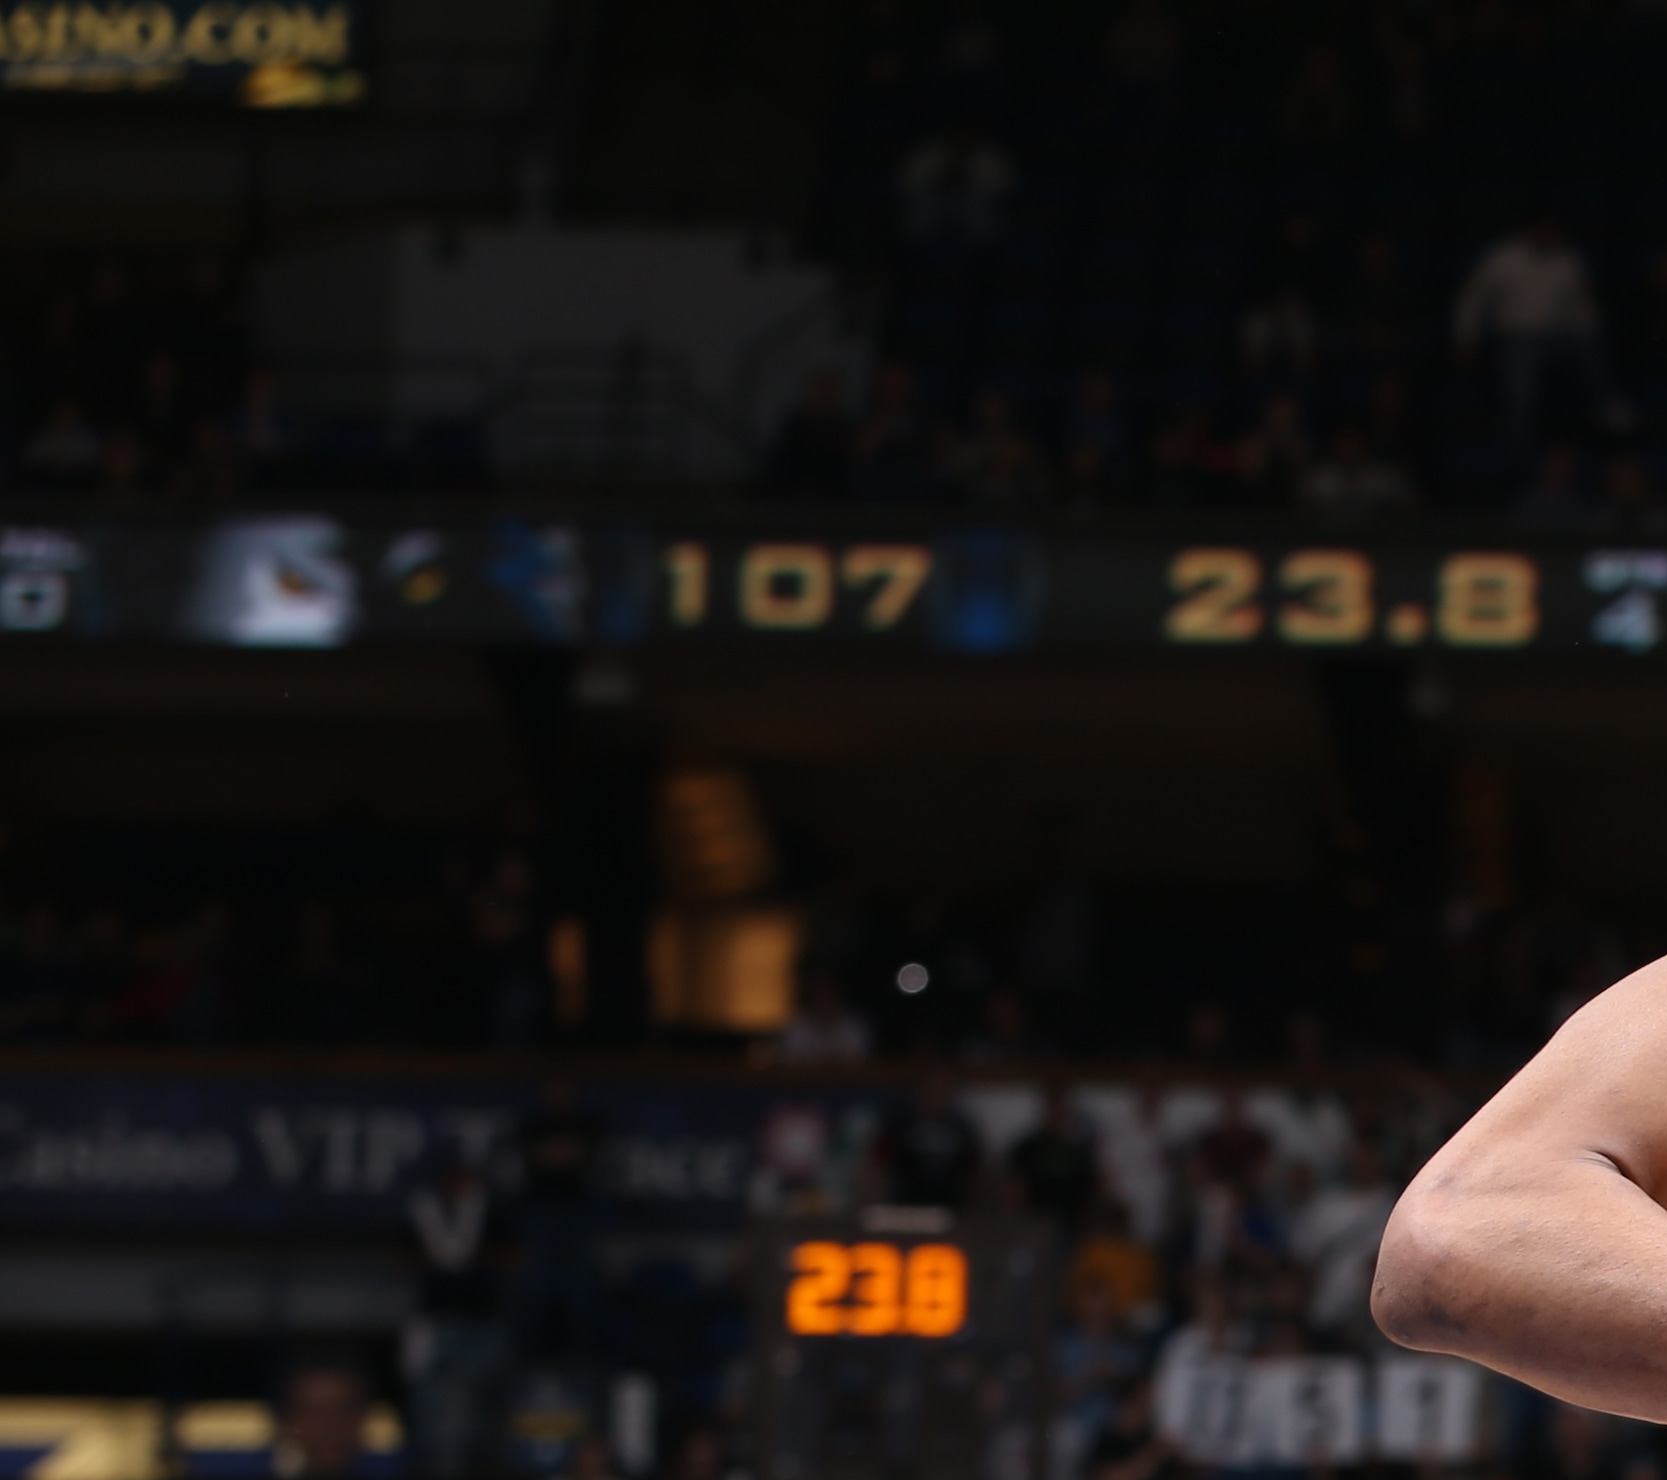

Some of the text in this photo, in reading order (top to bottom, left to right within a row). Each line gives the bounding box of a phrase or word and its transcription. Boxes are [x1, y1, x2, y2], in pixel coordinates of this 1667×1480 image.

[0, 2, 348, 64] SINO.COM
[661, 542, 932, 631] 107
[1165, 548, 1540, 647] 23.8
[250, 1106, 425, 1190] VIP
